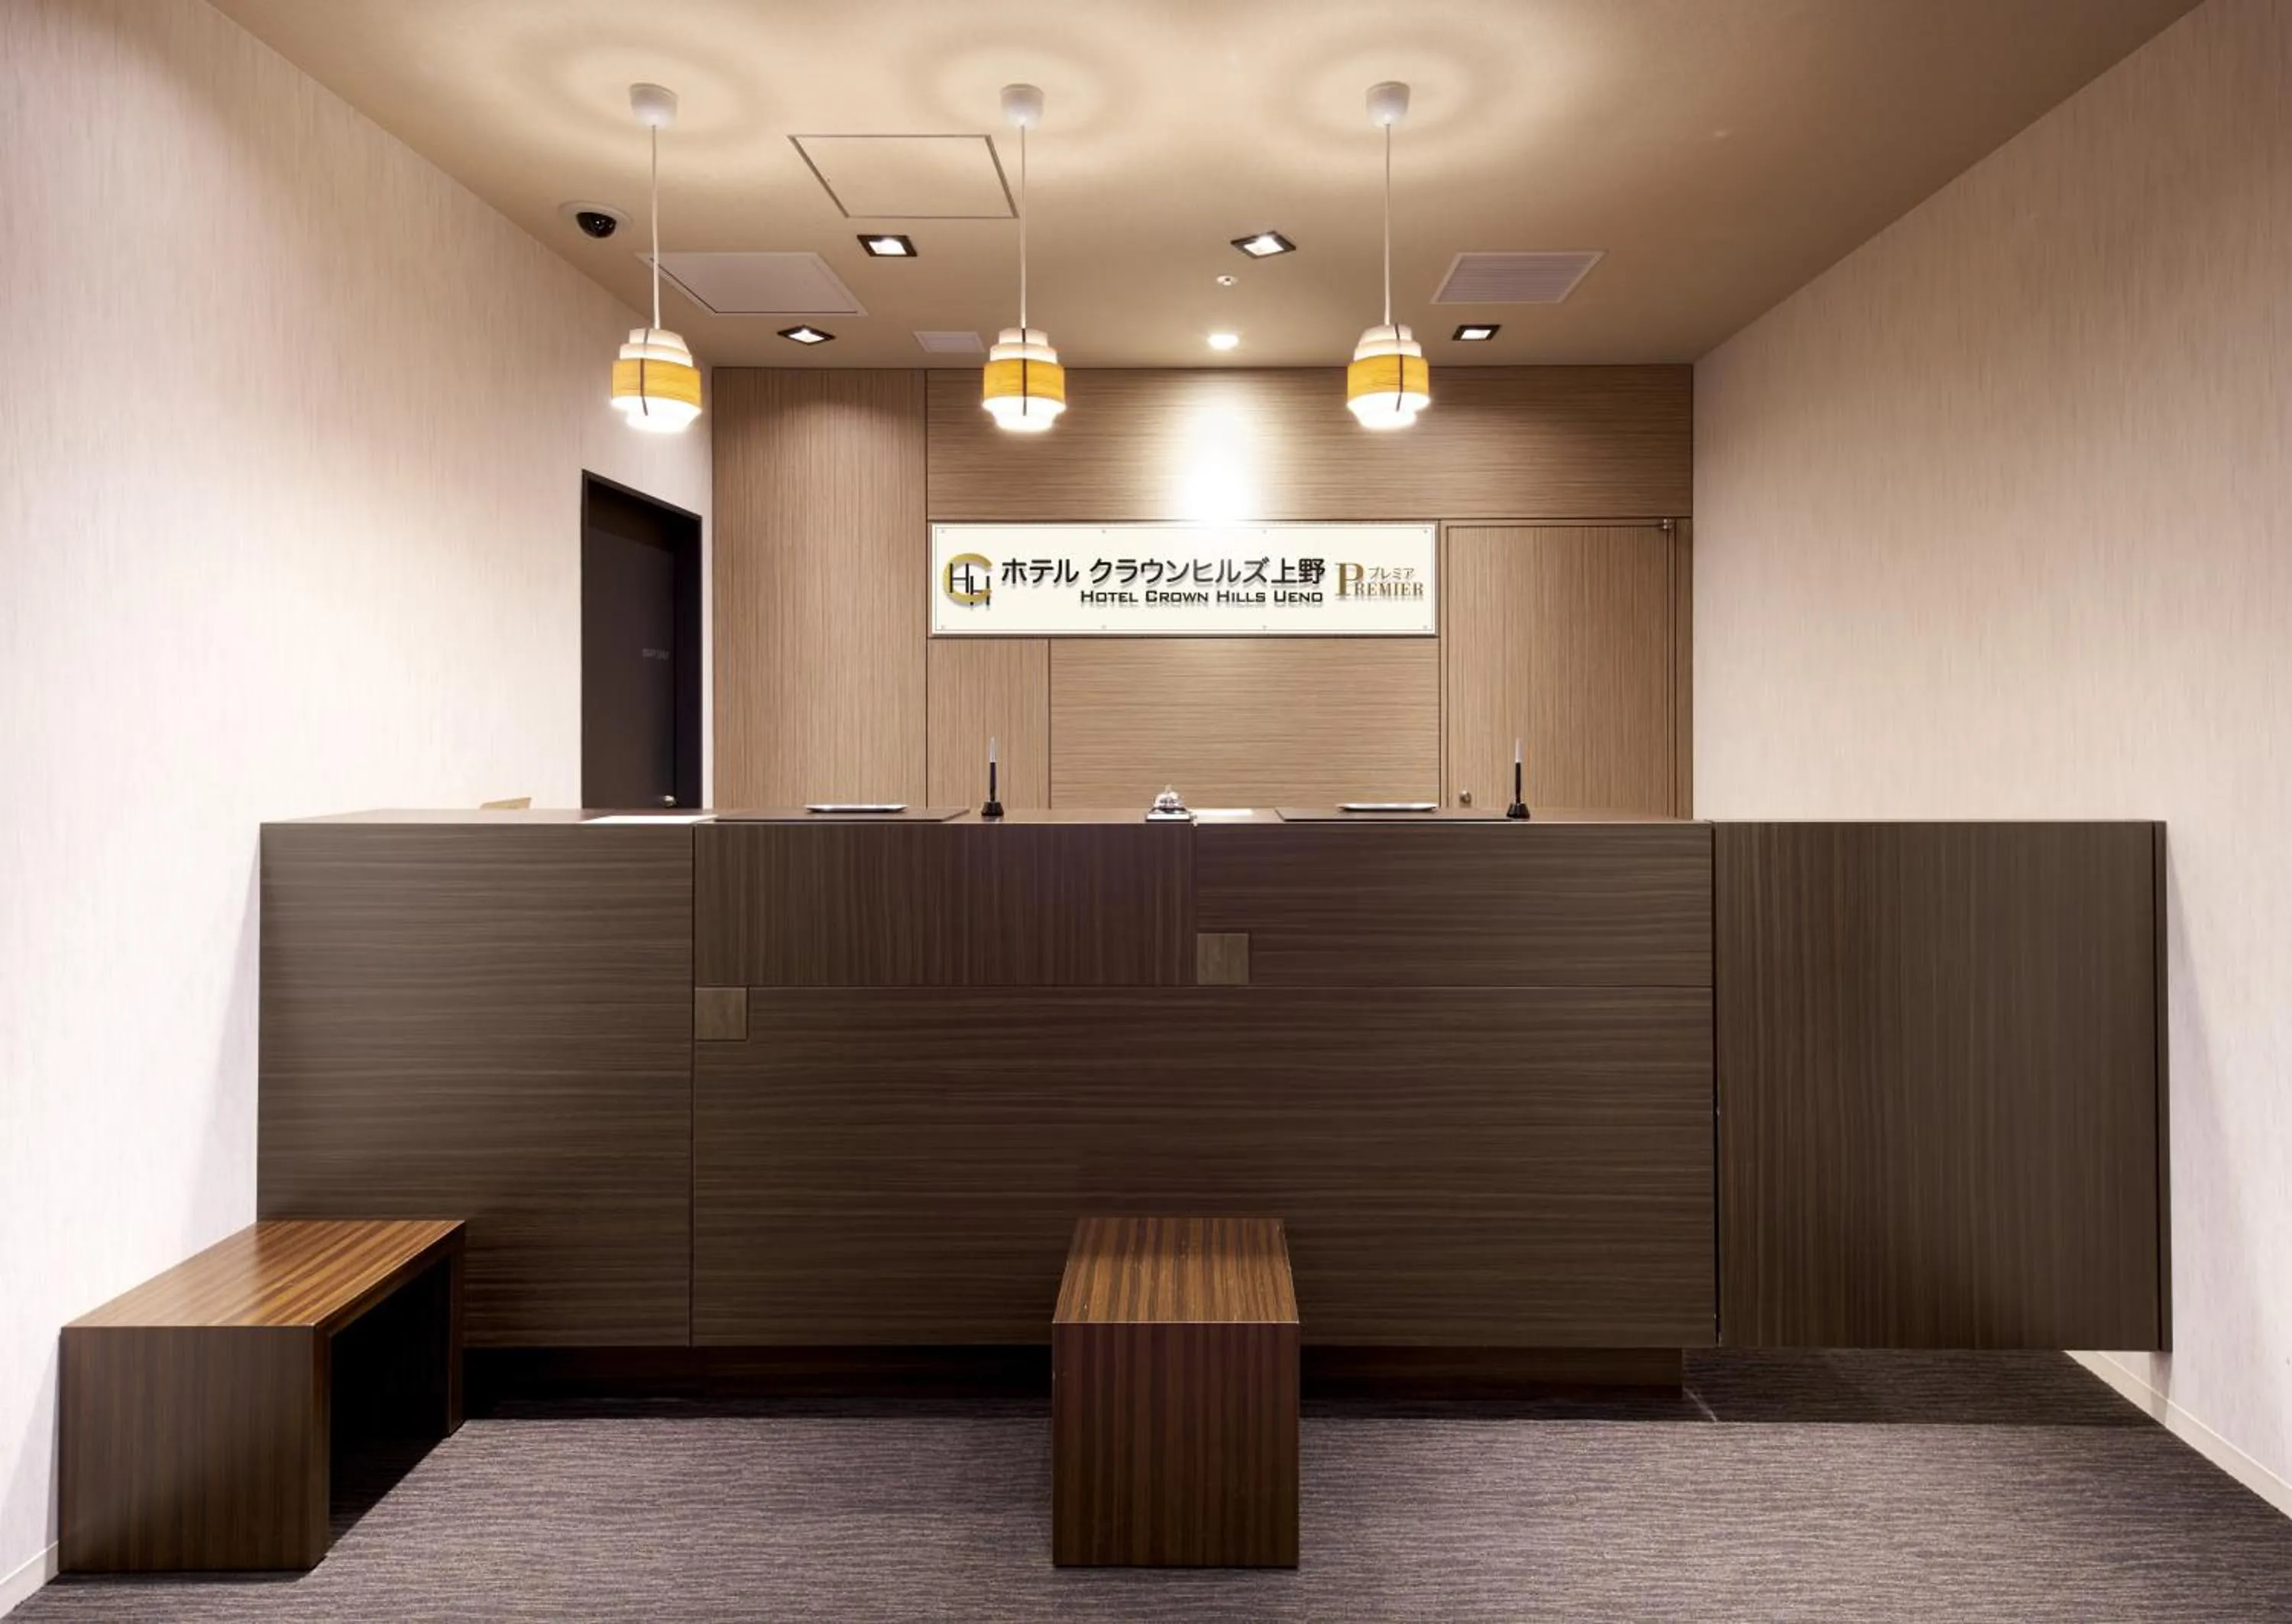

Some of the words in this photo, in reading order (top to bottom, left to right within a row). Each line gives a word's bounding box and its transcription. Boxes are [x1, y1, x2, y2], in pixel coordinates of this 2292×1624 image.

[1002, 558, 1080, 584] ホテル
[1089, 556, 1326, 584] クラウンヒルズ上野
[1335, 562, 1424, 597] PREMIER
[1368, 566, 1416, 580] プレミア
[1080, 590, 1138, 603] HOTEL
[1145, 590, 1209, 603] CROWN
[1216, 590, 1266, 603] HILLS
[1274, 590, 1323, 603] UENO
